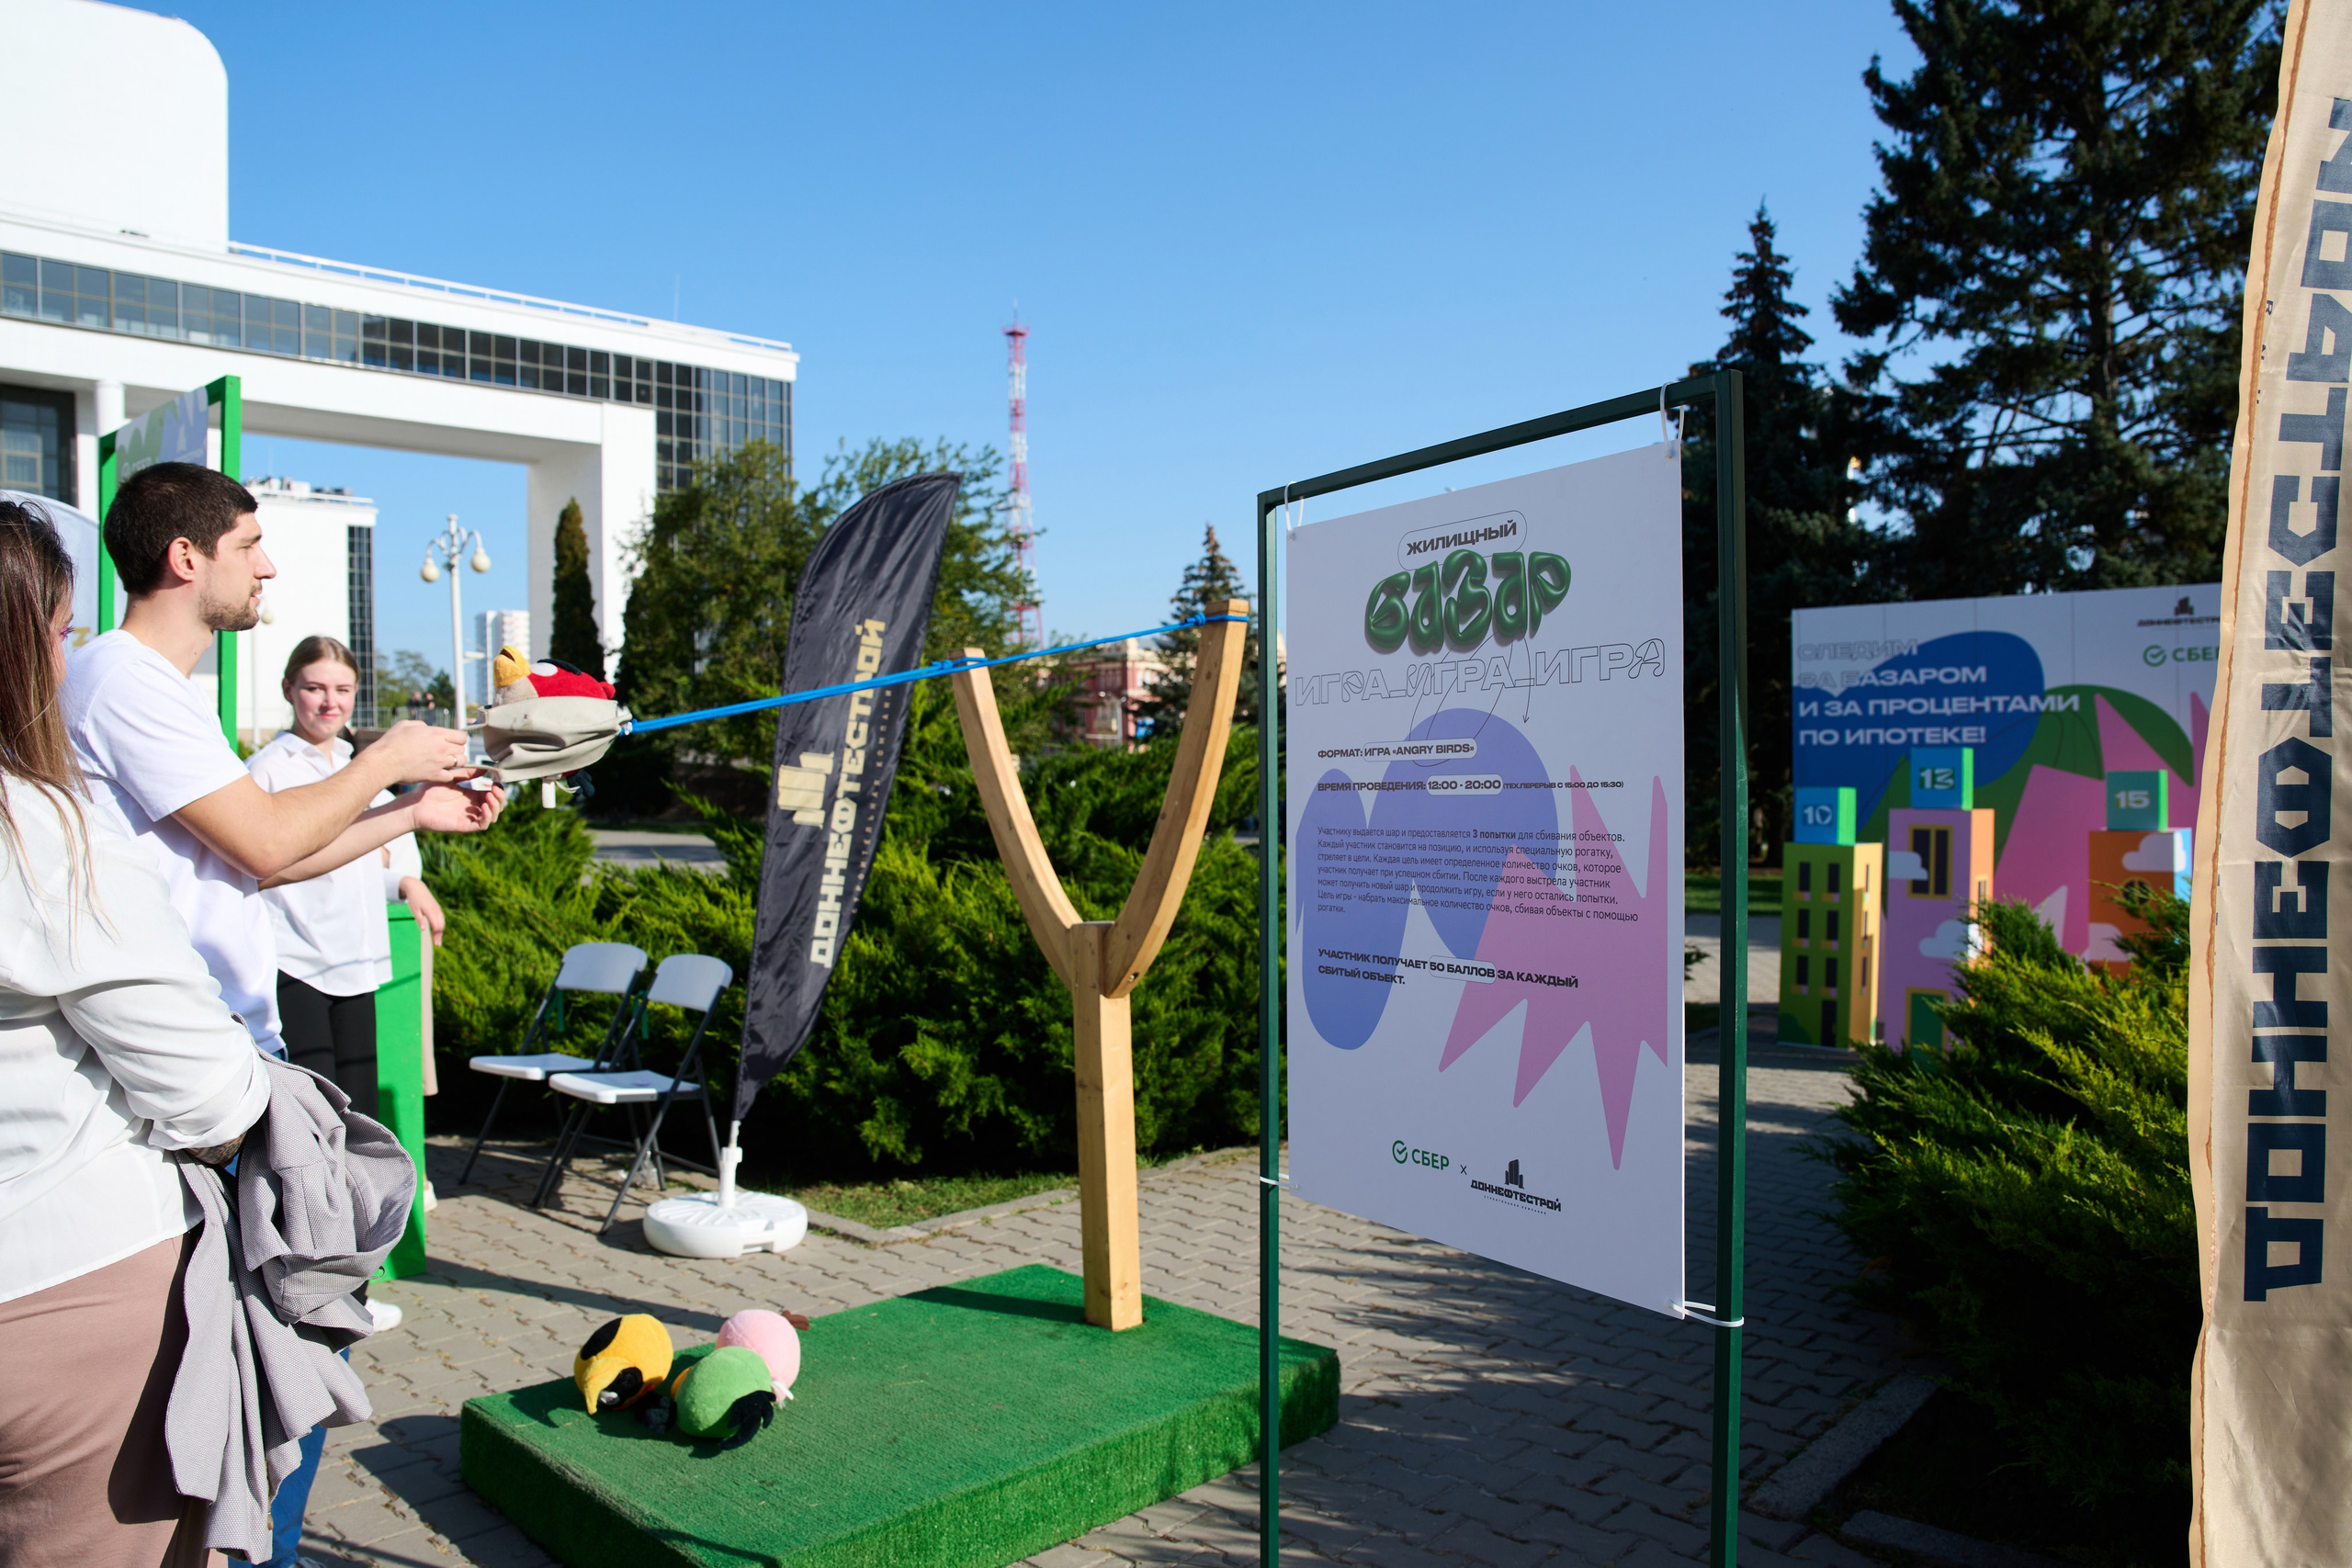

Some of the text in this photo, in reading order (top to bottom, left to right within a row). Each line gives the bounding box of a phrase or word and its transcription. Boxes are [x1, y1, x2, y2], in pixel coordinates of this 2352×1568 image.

[1406, 520, 1518, 556] ЖИЛИЩНЫЙ
[1798, 638, 1918, 661] СЛЕДИМ
[2172, 646, 2220, 662] СБЕ
[1798, 666, 1987, 689] ЗА БАЗАРОМ
[1799, 694, 2080, 717] И ЗА ПРОЦЕНТАМИ
[1799, 727, 1986, 746] ПО ИПОТЕКЕ!
[1317, 742, 1475, 759] ФОРМАТ: ИГРА «ANGRY BIRDS»
[1317, 782, 1351, 791] ВРЕМЯ
[1352, 781, 1426, 792] ПРОВЕДЕНИЯ:
[1427, 780, 1458, 790] 12:00
[1464, 779, 1501, 790] 20:00
[2115, 791, 2150, 809] 15
[1317, 826, 1351, 838] Участнику
[1352, 829, 1384, 837] выдается
[1385, 829, 1400, 839] шар
[1408, 829, 1471, 839] предоставляется
[1472, 829, 1477, 839] 3
[1479, 830, 1516, 840] попытки
[1517, 831, 1533, 840] для
[1534, 829, 1577, 840] сбивания
[1578, 829, 1625, 842] объектов.
[1317, 839, 1344, 849] Каждый
[1345, 841, 1375, 851] участник
[1376, 842, 1416, 851] становится
[1418, 843, 1427, 852] на
[1428, 843, 1464, 854] позицию,
[1472, 845, 1514, 856] используя
[1515, 846, 1573, 858] специальную
[1574, 848, 1613, 860] рогатку,
[1317, 852, 1346, 862] стреляет
[1352, 854, 1372, 863] цели.
[1373, 853, 1400, 864] Каждая
[1401, 856, 1419, 865] цель
[1419, 857, 1442, 865] имеет
[1443, 858, 1500, 868] определенное
[1501, 860, 1550, 871] количество
[1551, 863, 1581, 874] очков,
[1583, 861, 1622, 874] которое
[1317, 866, 1611, 888] участник получает при успешном сбитии. После каждого выстрела участник
[1317, 878, 1338, 886] может
[1339, 880, 1370, 889] получить
[1371, 880, 1393, 890] новый
[1394, 883, 1409, 893] шар
[1417, 885, 1463, 895] продолжить
[1464, 887, 1484, 898] игру,
[1486, 888, 1505, 897] если
[1506, 889, 1512, 900] у
[1513, 890, 1533, 899] него
[1533, 891, 1575, 902] остались
[1576, 894, 1618, 905] попытки.
[1317, 889, 1334, 899] Цель
[1335, 893, 1351, 902] игры
[1358, 892, 1385, 903] набрать
[1386, 896, 1439, 908] максимальное
[1440, 900, 1485, 910] количество
[1486, 903, 1512, 914] очков,
[1514, 902, 1544, 915] сбивая
[1545, 904, 1583, 918] объекты
[1585, 909, 1591, 919] с
[1592, 910, 1638, 922] помощью
[1317, 904, 1345, 912] рогатки.
[1317, 948, 1578, 988] УЧАСТНИК ПОЛУЧАЕТ 50 БАЛЛОВ ЗА КАЖДЫЙ
[1317, 964, 1407, 986] СБИТЫЙ ОБЪЕКТ.
[1411, 1148, 1450, 1170] СБЕР
[1470, 1179, 1562, 1212] ДОННЕФТЕСТРОЙ
